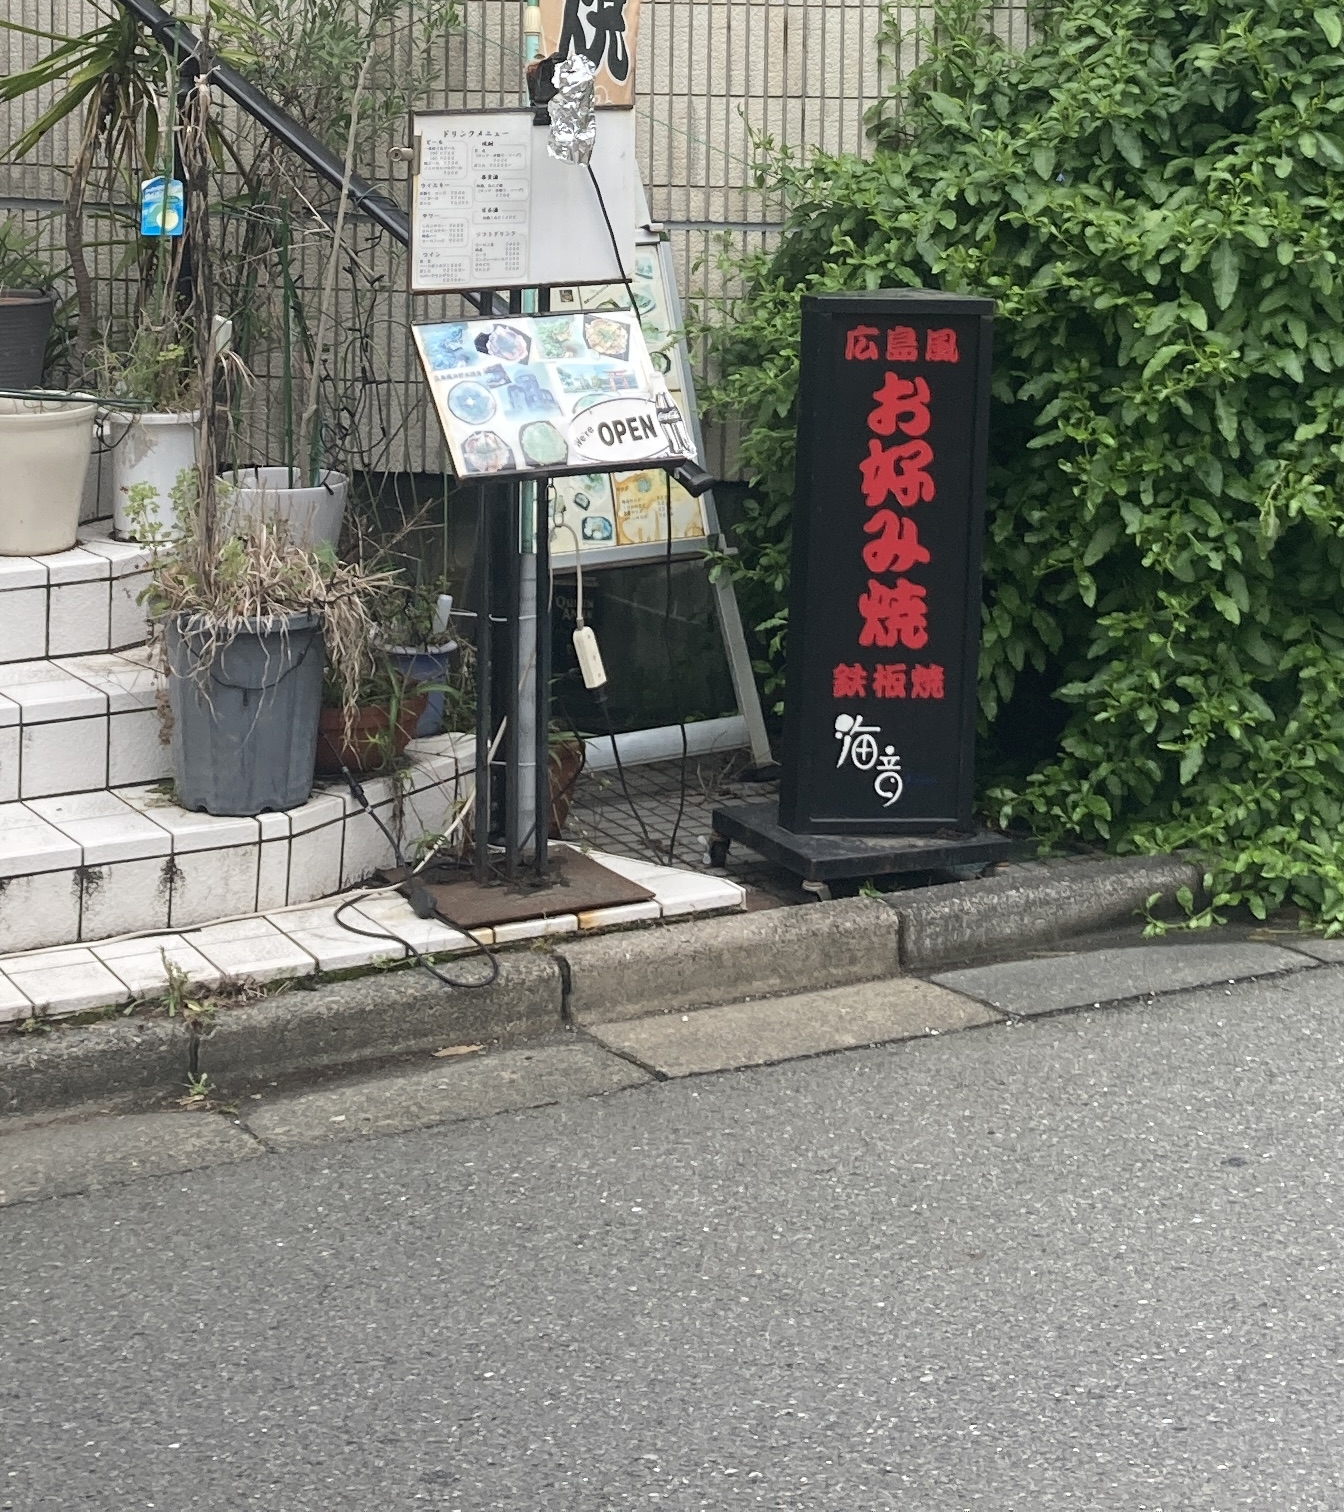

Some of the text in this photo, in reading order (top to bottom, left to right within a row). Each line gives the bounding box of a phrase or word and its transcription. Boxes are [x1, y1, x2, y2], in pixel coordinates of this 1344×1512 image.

[443, 129, 509, 138] ドリンクメニュー
[844, 324, 959, 363] 広島風
[597, 414, 658, 447] OPEN
[858, 370, 936, 651] お好み焼
[831, 662, 946, 699] 鉄板焼
[834, 713, 904, 808] 海音
